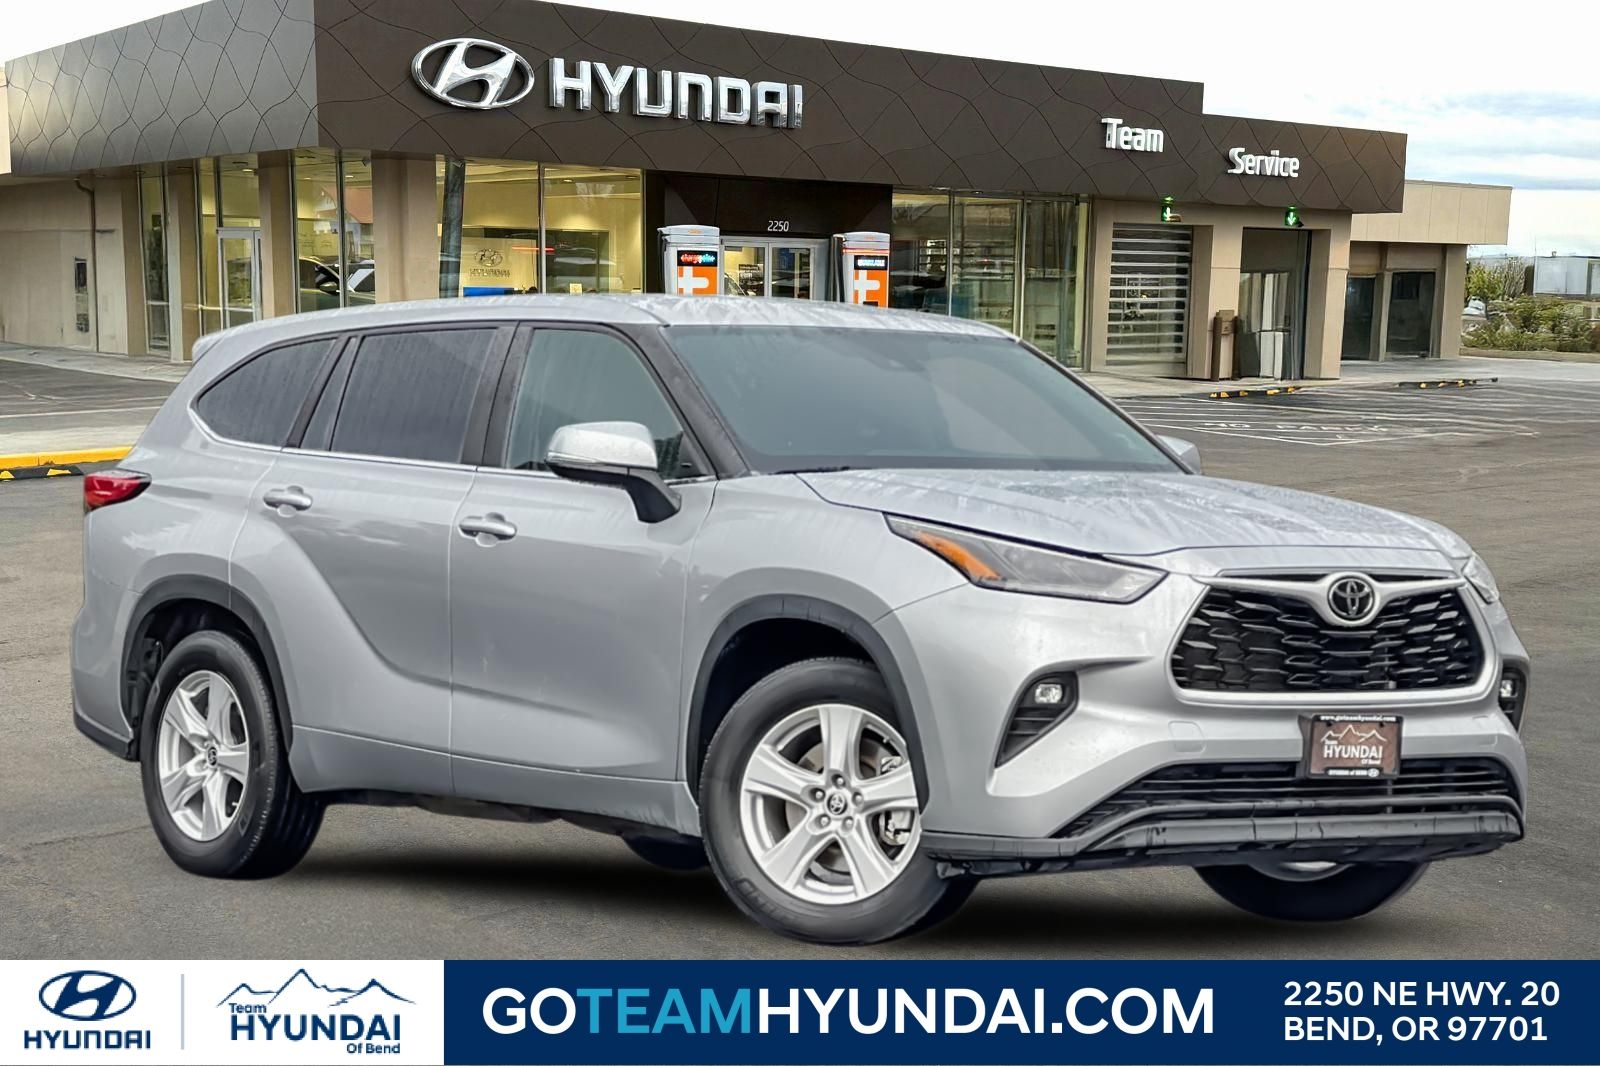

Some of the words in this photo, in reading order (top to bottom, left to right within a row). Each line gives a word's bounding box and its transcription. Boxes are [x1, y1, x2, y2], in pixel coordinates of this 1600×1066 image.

[549, 57, 803, 129] HYUNDAI
[1101, 117, 1164, 153] Team
[1227, 147, 1300, 178] Service
[767, 220, 790, 232] 2250
[1323, 745, 1383, 759] HYUNDAI
